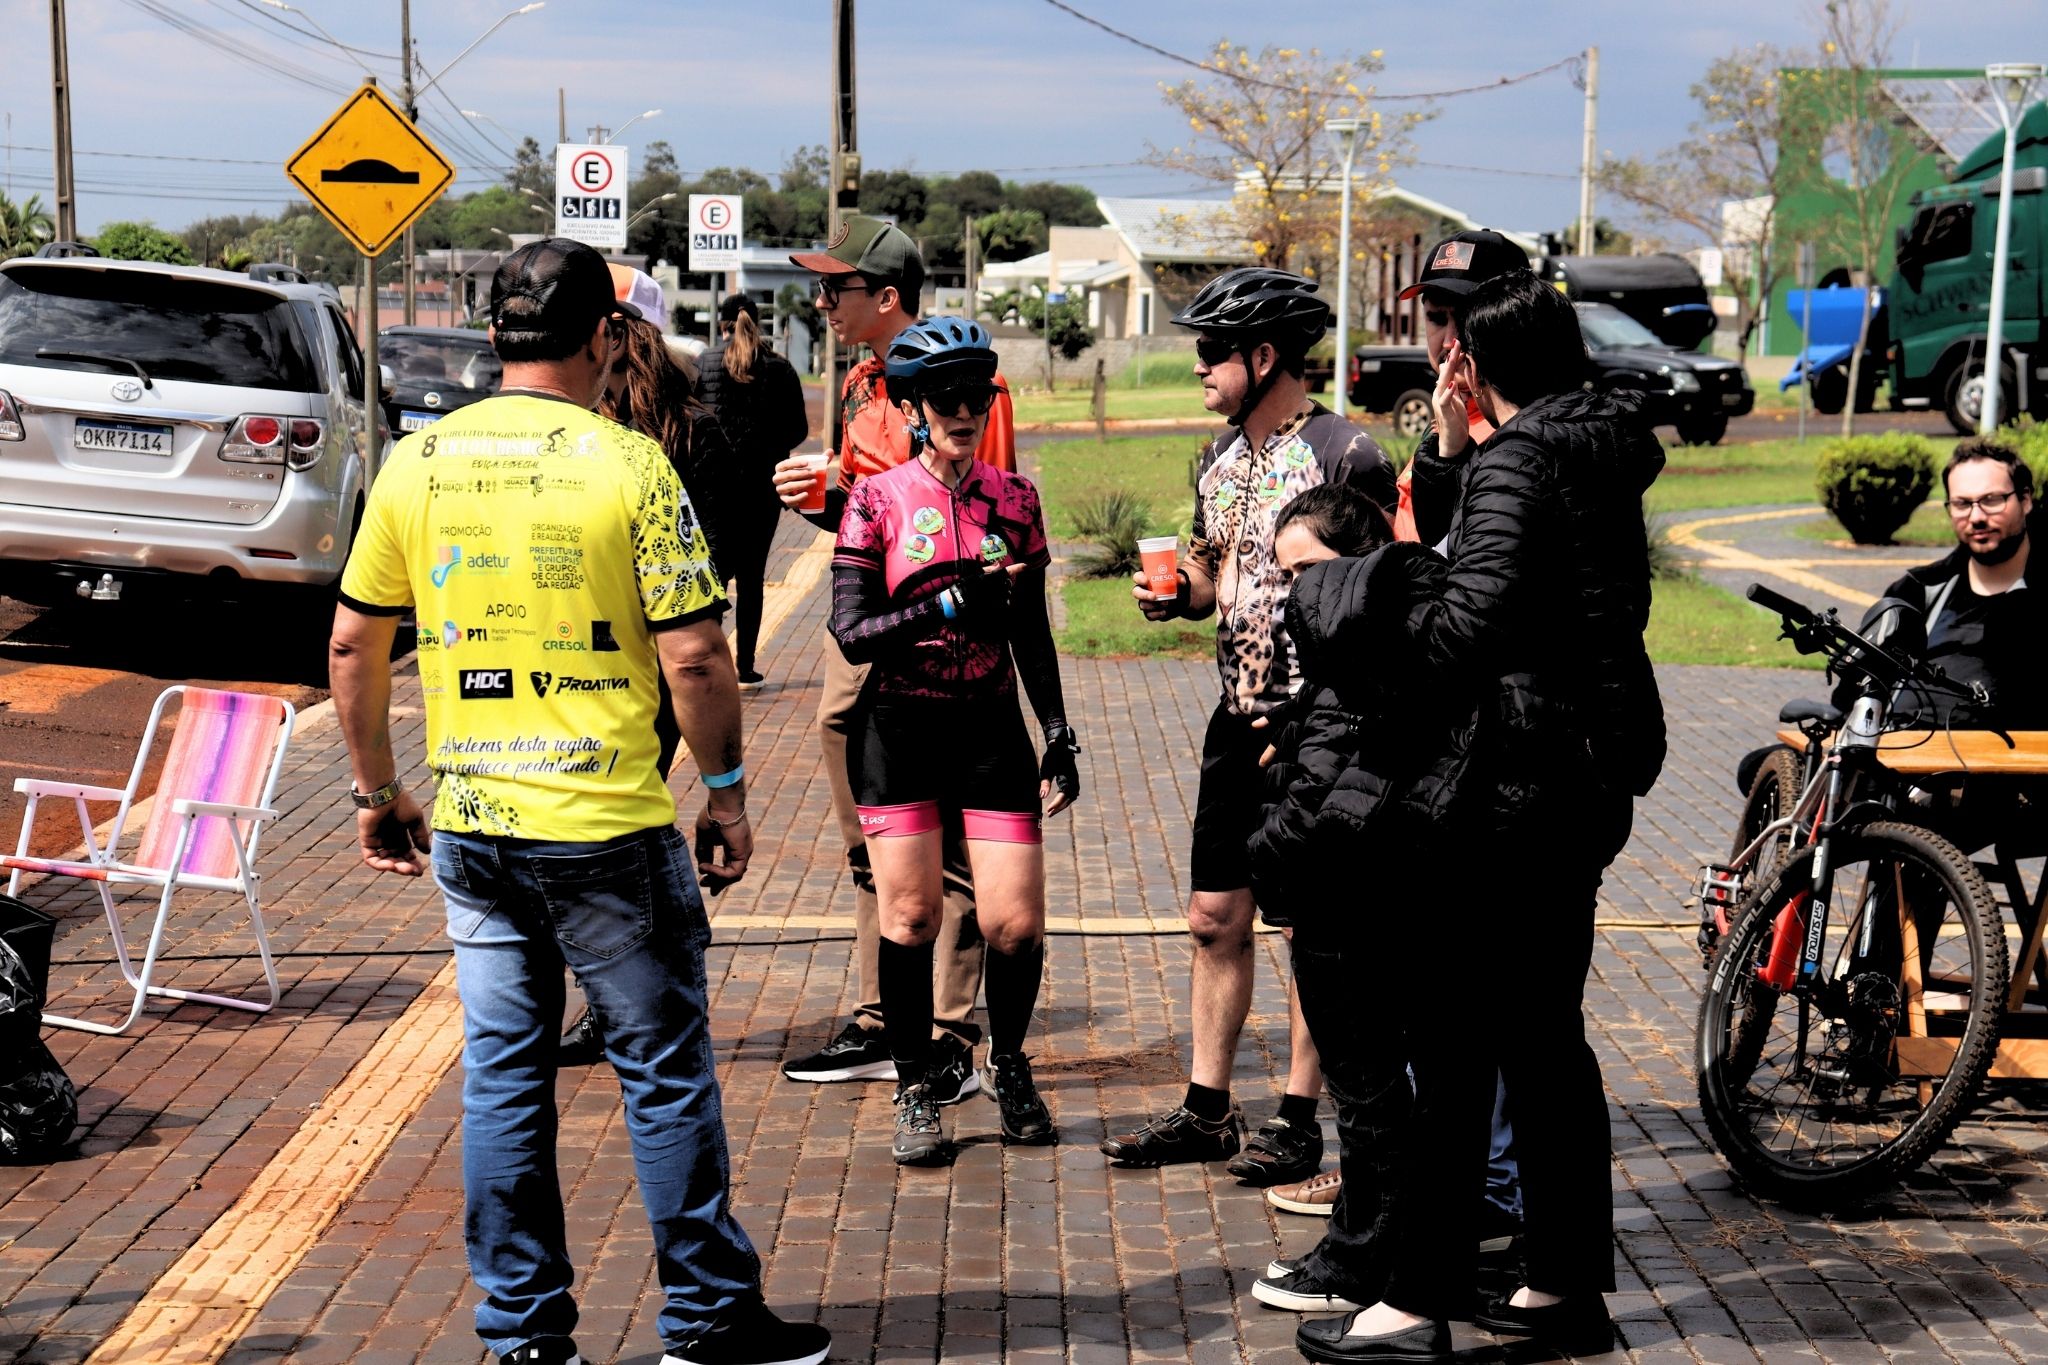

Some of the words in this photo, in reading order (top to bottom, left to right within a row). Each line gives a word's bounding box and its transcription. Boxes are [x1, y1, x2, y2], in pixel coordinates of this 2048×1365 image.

[584, 161, 600, 184] E
[709, 207, 721, 224] E
[1435, 258, 1464, 266] CRESOL
[531, 431, 543, 439] DE
[421, 434, 437, 458] 8
[439, 524, 492, 538] PROMOÇÃO
[531, 523, 583, 535] ORGANIZAÇÃO
[536, 533, 580, 543] REALIZAÇÃO
[529, 546, 584, 557] PREFEITURAS
[467, 553, 510, 568] adetur
[533, 556, 580, 565] MUNICIPAIS
[544, 564, 577, 573] GRUPOS
[531, 572, 543, 581] DE
[545, 572, 584, 583] CICLISTAS
[1150, 574, 1176, 582] CRESOL
[536, 580, 549, 589] DA
[550, 580, 581, 590] REGIÃO
[485, 604, 527, 618] APOIO
[467, 628, 488, 642] PTI
[542, 640, 588, 651] CRESOL
[464, 672, 507, 690] HDC
[555, 676, 630, 695] PROATIVA
[507, 736, 546, 752] desta
[554, 737, 602, 757] região
[513, 756, 601, 780] pedalando
[1711, 877, 1782, 994] SCHWALBE
[1807, 919, 1822, 960] SUNTOUR
